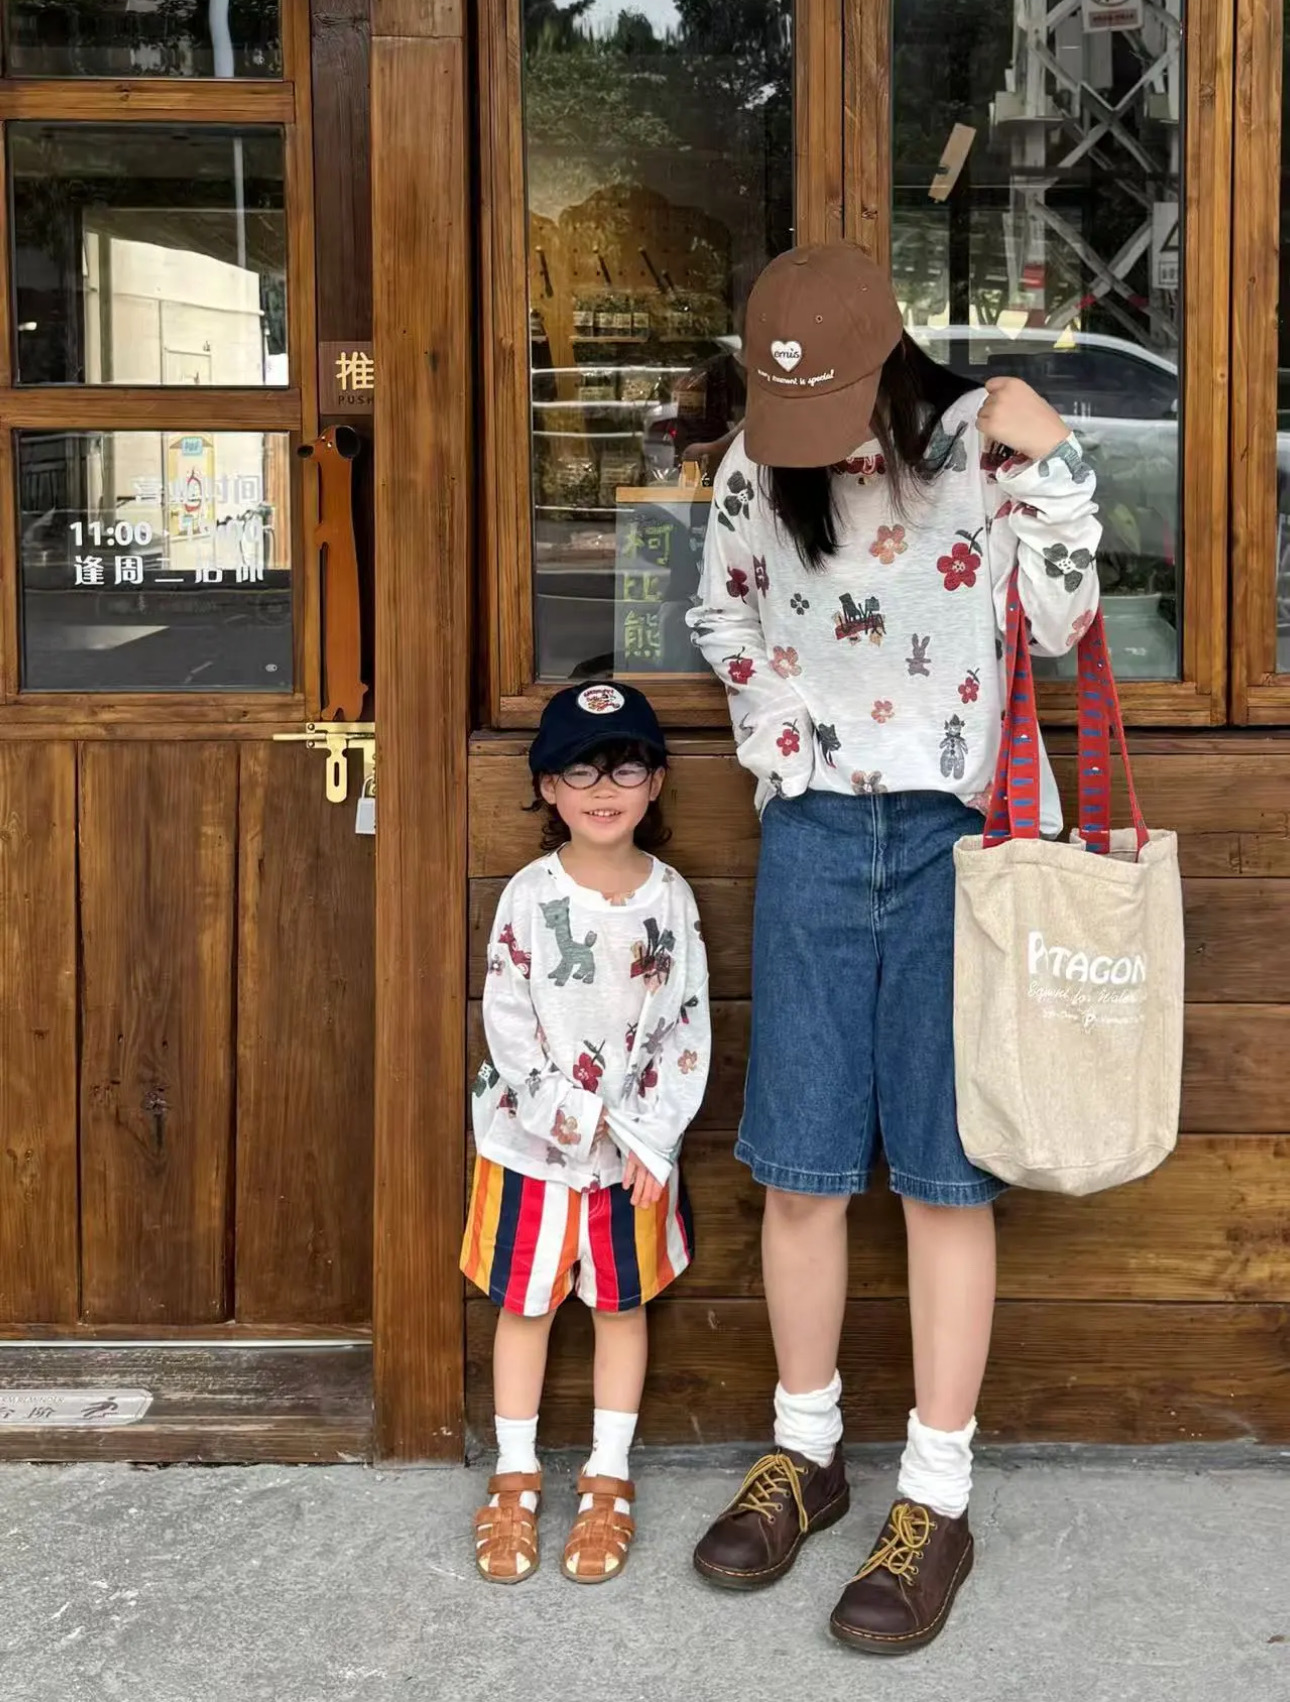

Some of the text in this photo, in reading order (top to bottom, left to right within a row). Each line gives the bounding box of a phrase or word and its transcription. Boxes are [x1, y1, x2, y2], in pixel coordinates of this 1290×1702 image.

[773, 348, 800, 358] emis
[335, 351, 375, 390] 推
[69, 521, 152, 546] 11:00
